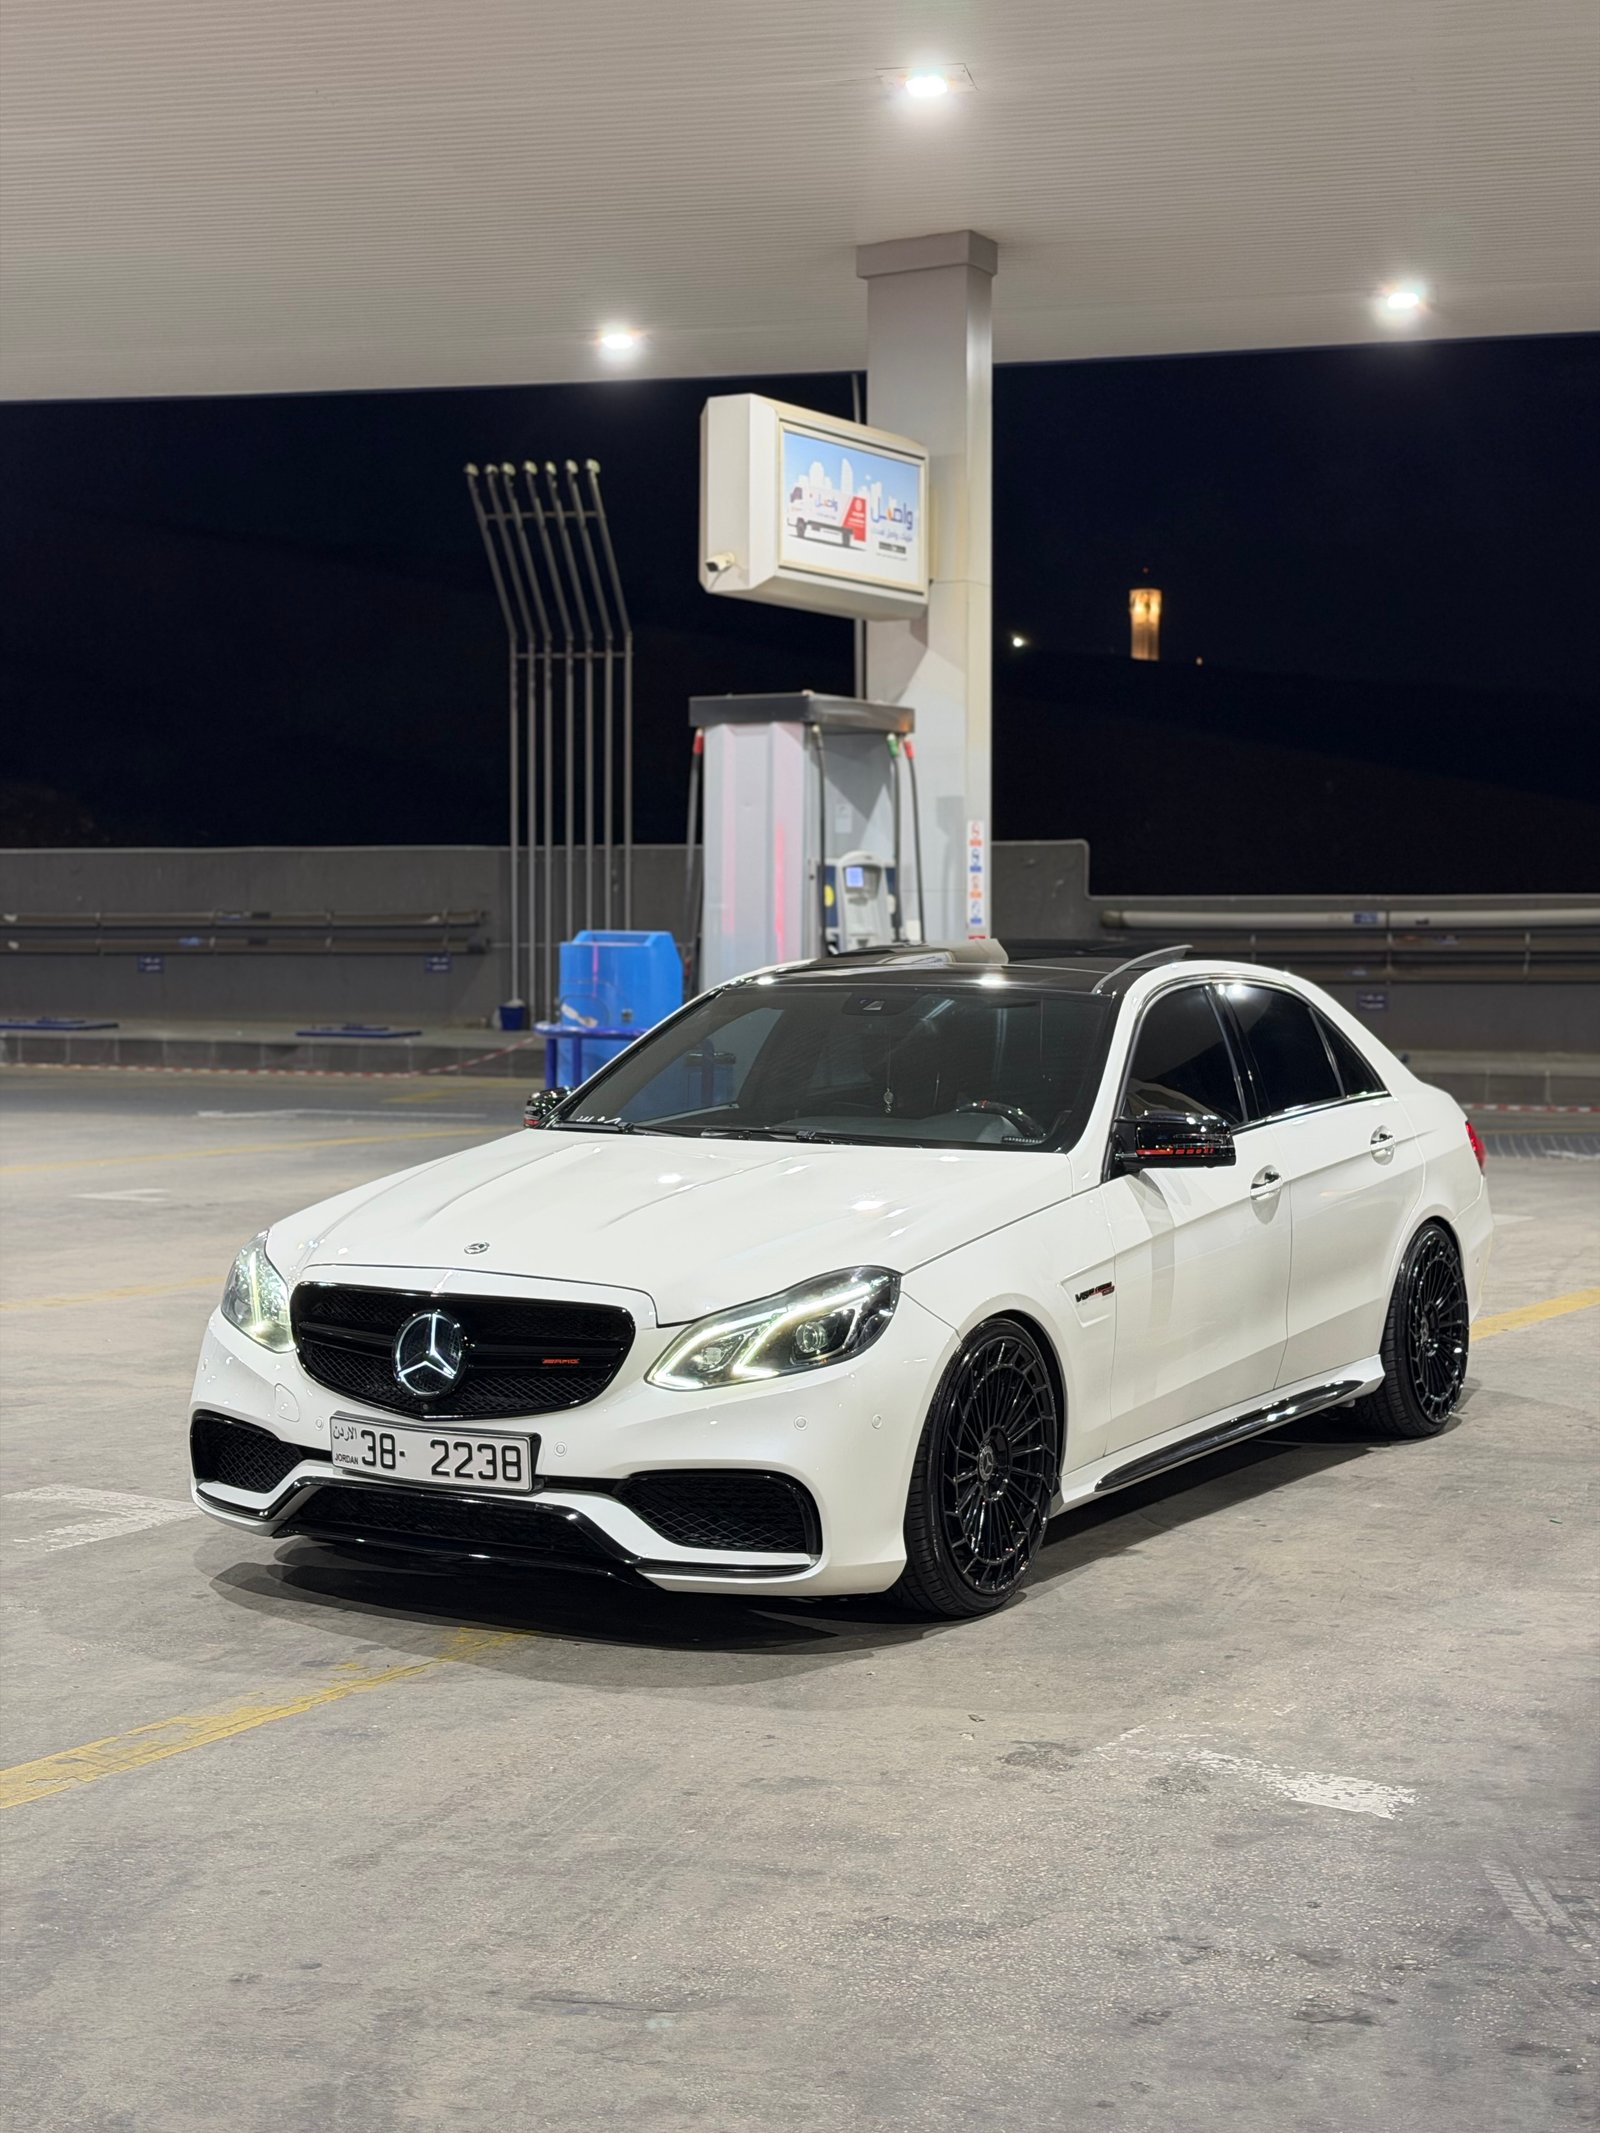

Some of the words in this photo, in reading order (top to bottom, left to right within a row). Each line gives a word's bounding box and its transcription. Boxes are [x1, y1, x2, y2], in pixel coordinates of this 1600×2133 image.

[871, 496, 913, 530] واصل
[335, 1453, 359, 1465] JORDAN
[430, 1439, 522, 1482] 2238
